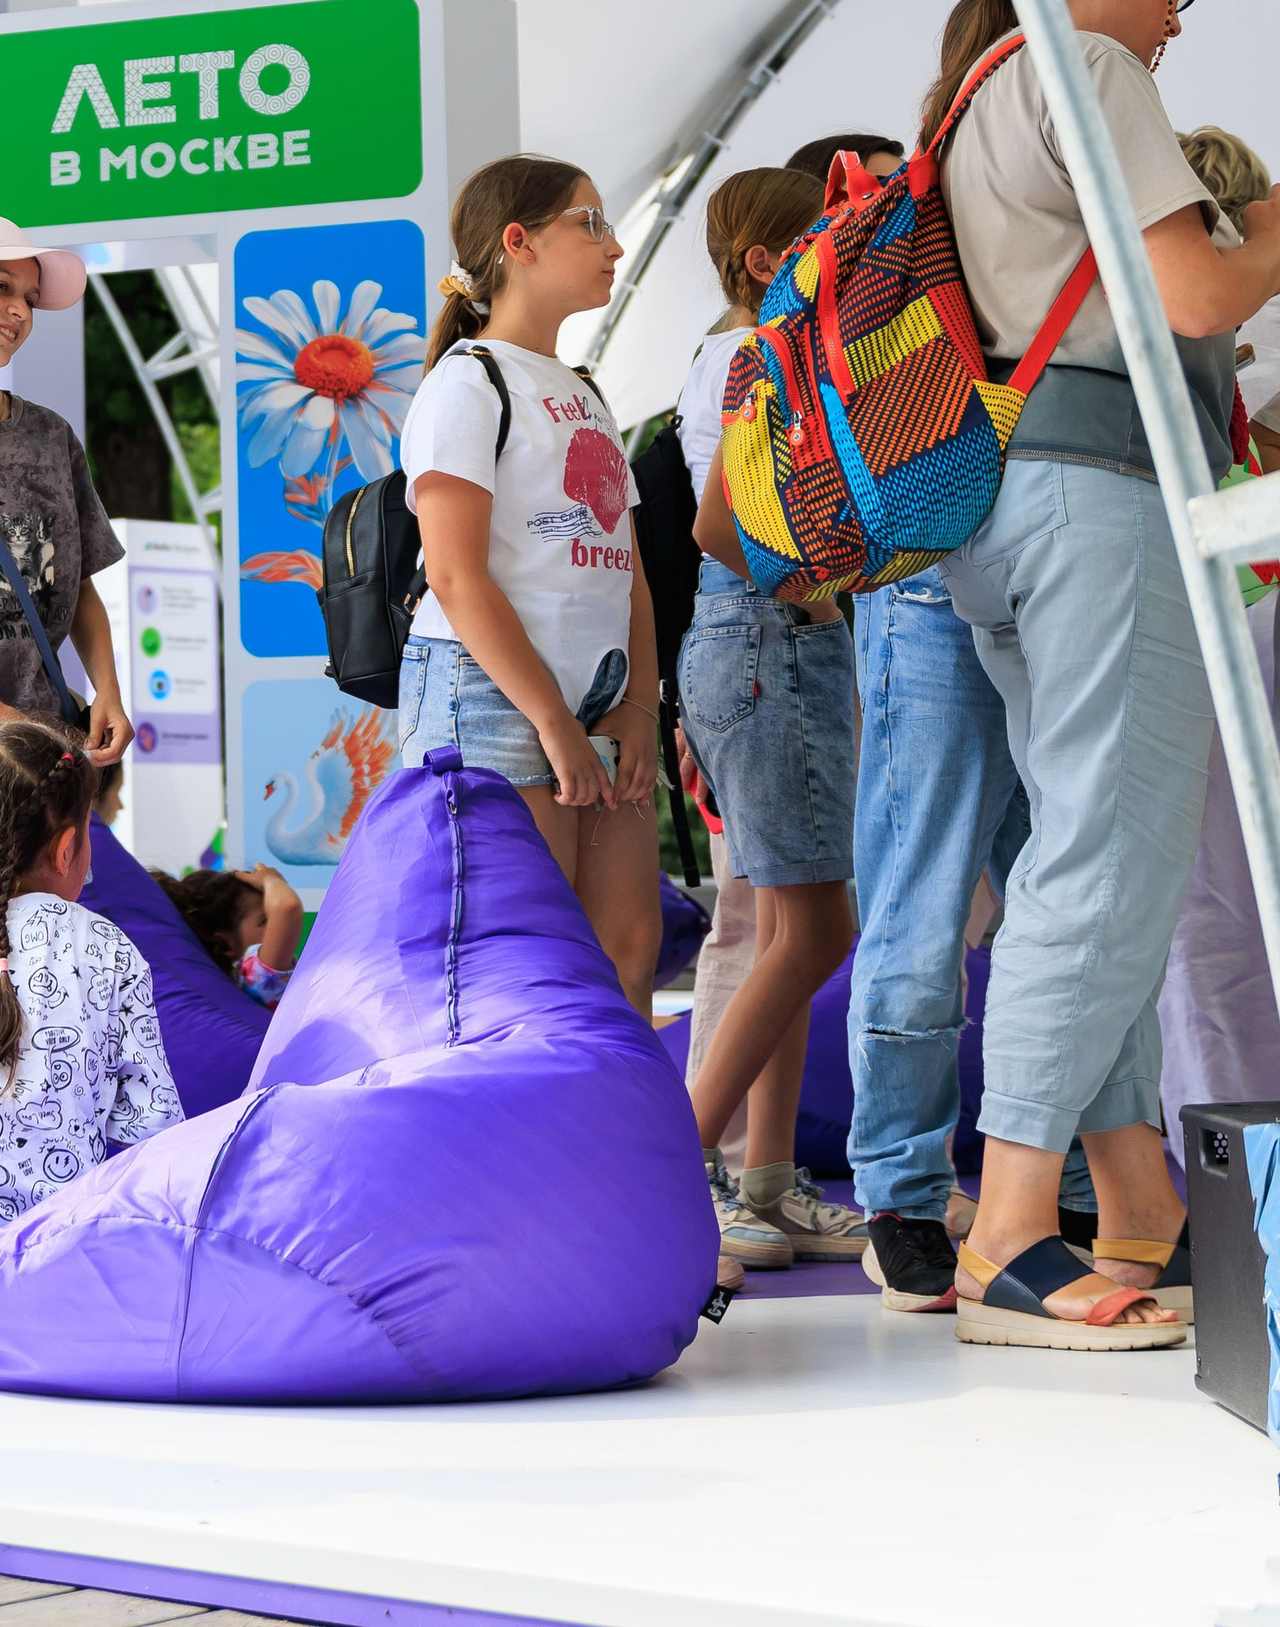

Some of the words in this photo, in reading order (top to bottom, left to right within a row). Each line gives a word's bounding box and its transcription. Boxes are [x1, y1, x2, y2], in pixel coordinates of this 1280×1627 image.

[51, 43, 311, 134] ЛЕТО
[50, 150, 81, 187] В
[99, 129, 312, 183] МОСКВЕ
[526, 516, 555, 529] POST
[571, 537, 633, 572] breez
